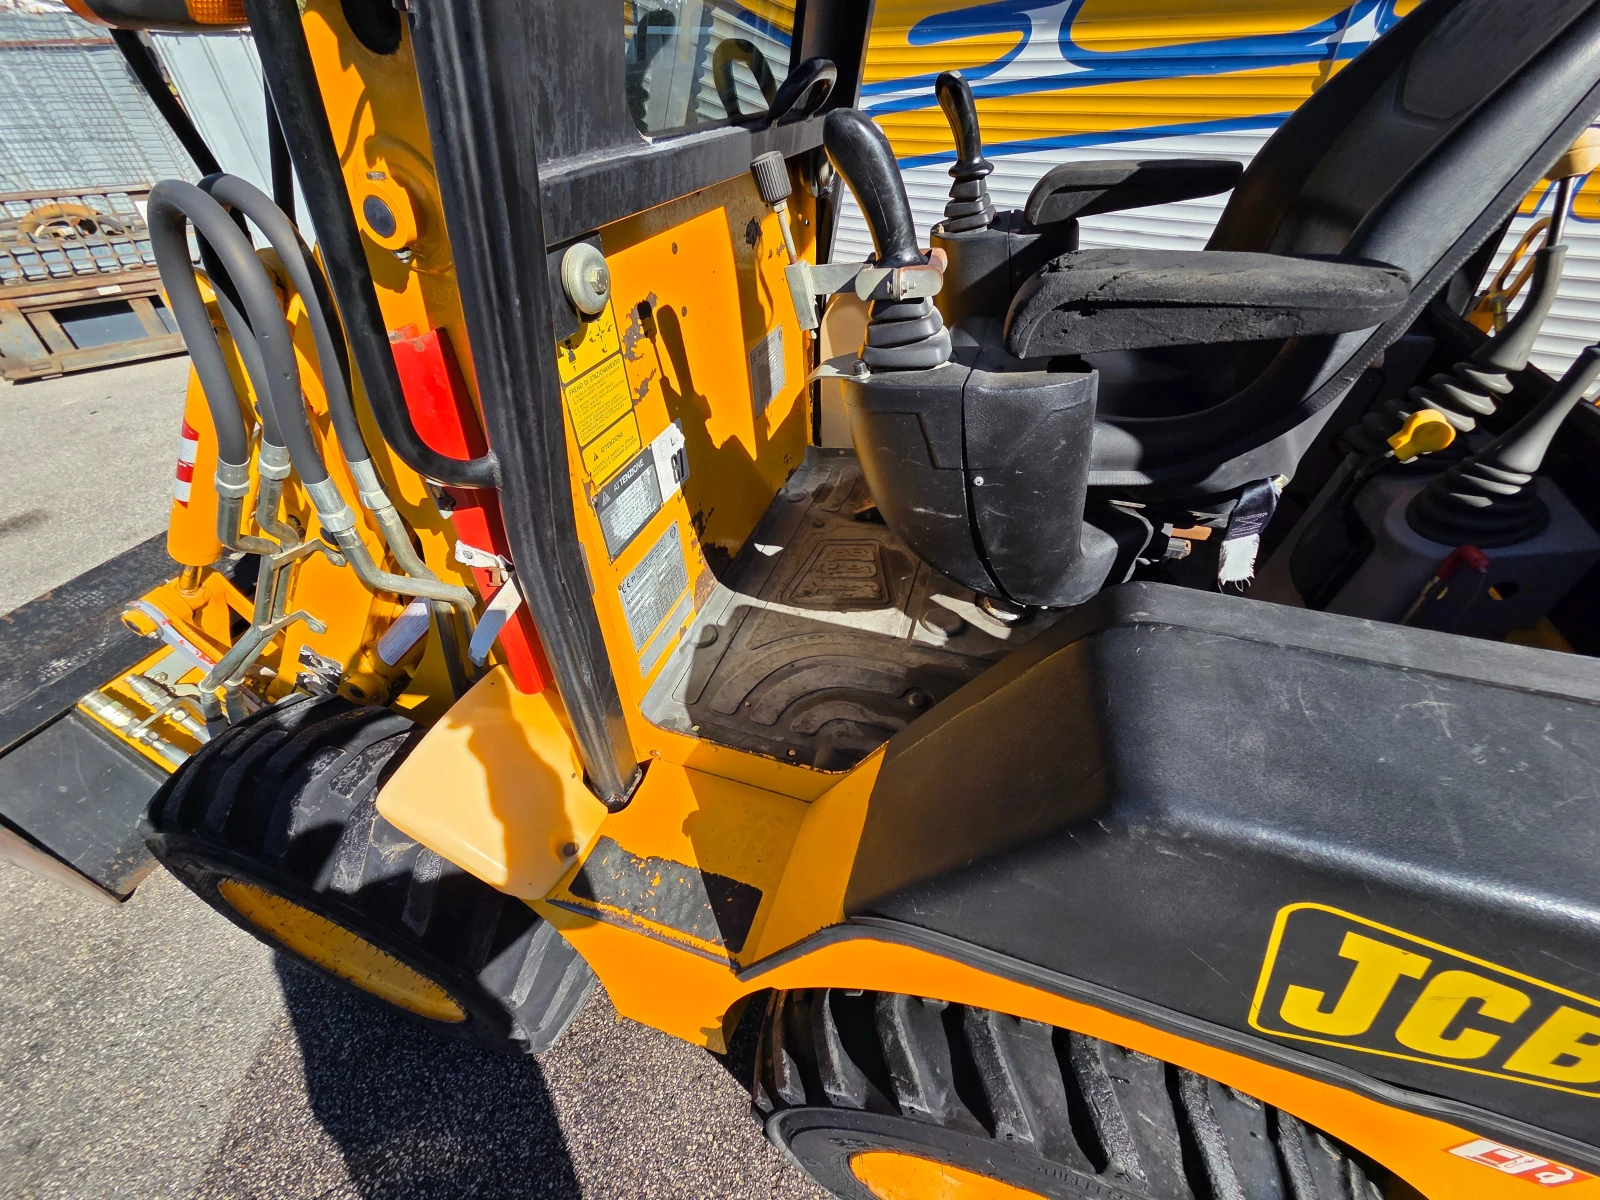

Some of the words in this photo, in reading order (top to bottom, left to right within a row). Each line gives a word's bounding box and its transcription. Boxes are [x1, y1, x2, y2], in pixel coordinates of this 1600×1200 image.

[569, 383, 584, 396] FRENO
[600, 431, 624, 454] ATTENZIONE
[613, 458, 645, 492] ATTENZIONE
[1279, 931, 1600, 1084] JCB
